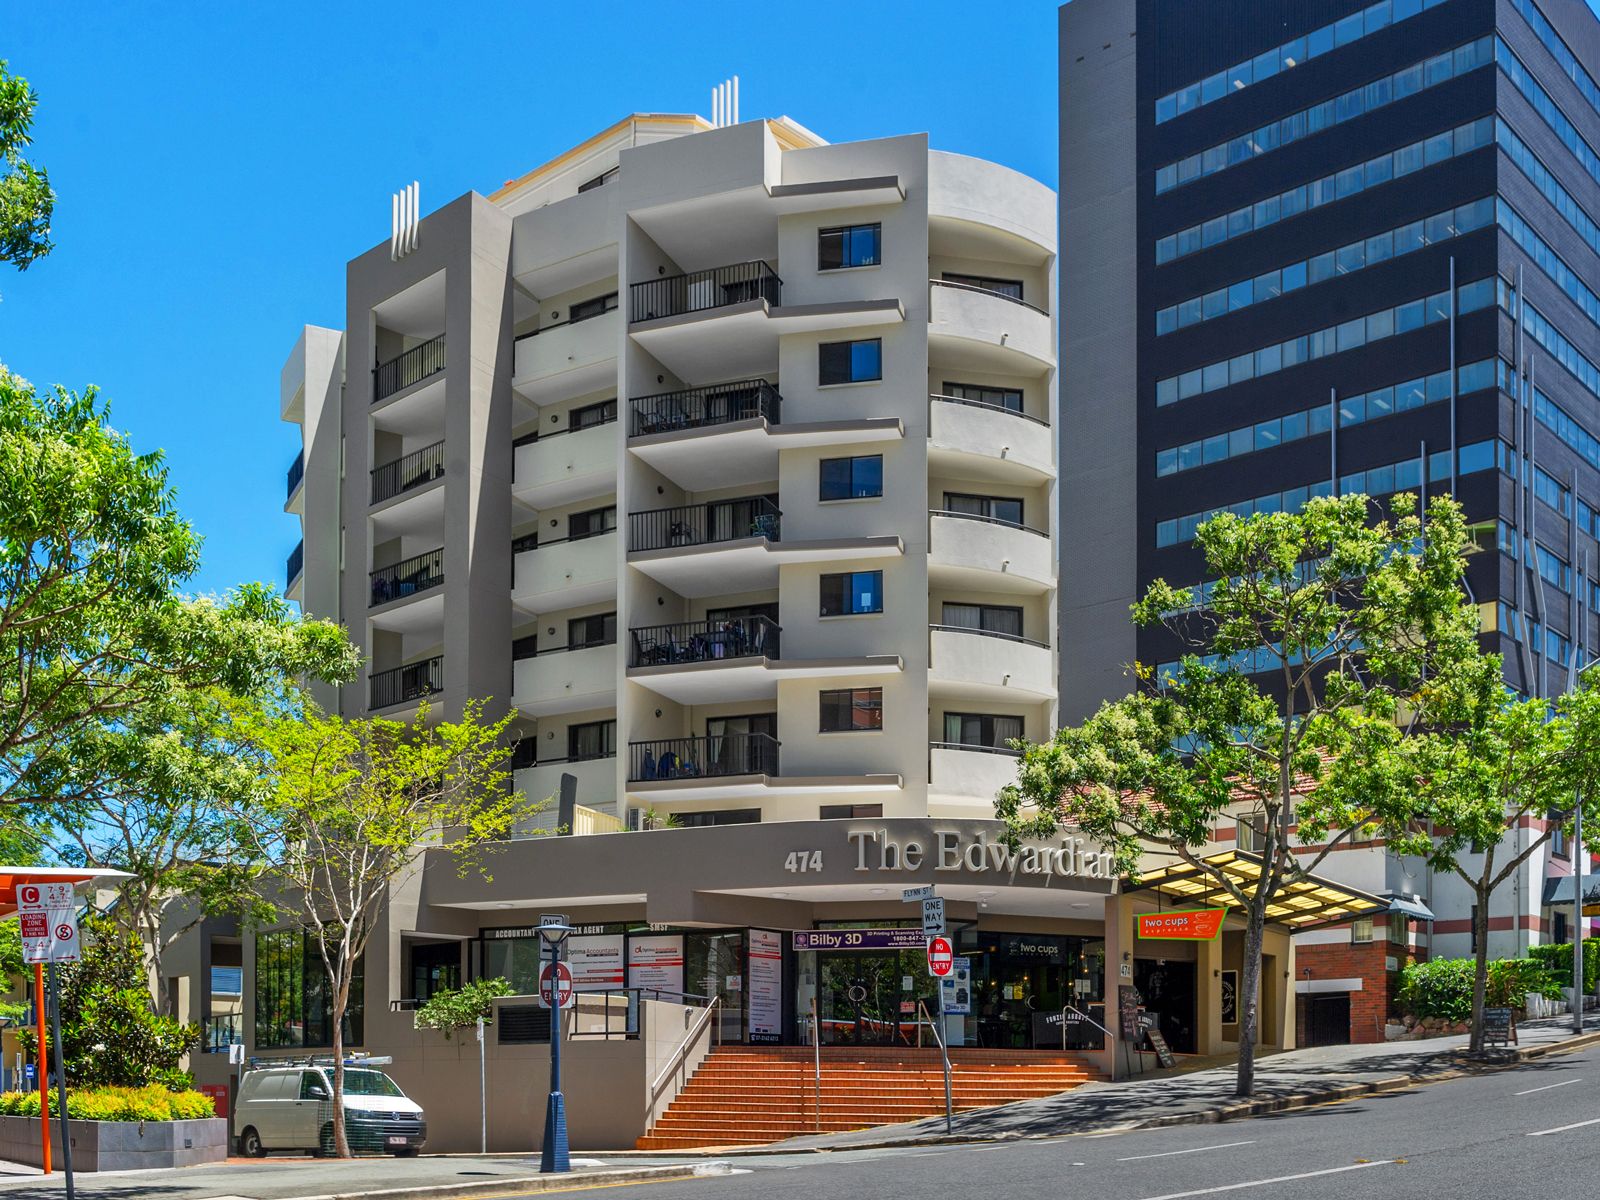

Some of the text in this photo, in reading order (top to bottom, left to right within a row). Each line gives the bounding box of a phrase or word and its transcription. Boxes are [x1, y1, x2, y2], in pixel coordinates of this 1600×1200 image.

[847, 828, 1119, 880] The Edwardian
[784, 850, 823, 873] 474
[903, 886, 930, 898] FLYNN ST
[925, 900, 941, 910] ONE
[924, 912, 943, 922] WAY
[1145, 917, 1189, 928] two cups
[495, 928, 536, 938] ACCOUNTANT
[583, 925, 604, 935] AGENT
[809, 933, 863, 948] Bilby 3D
[935, 943, 944, 951] NO
[1020, 942, 1037, 952] two
[1037, 945, 1059, 955] cups
[932, 962, 950, 970] ENTRY
[544, 991, 568, 1001] ERY
